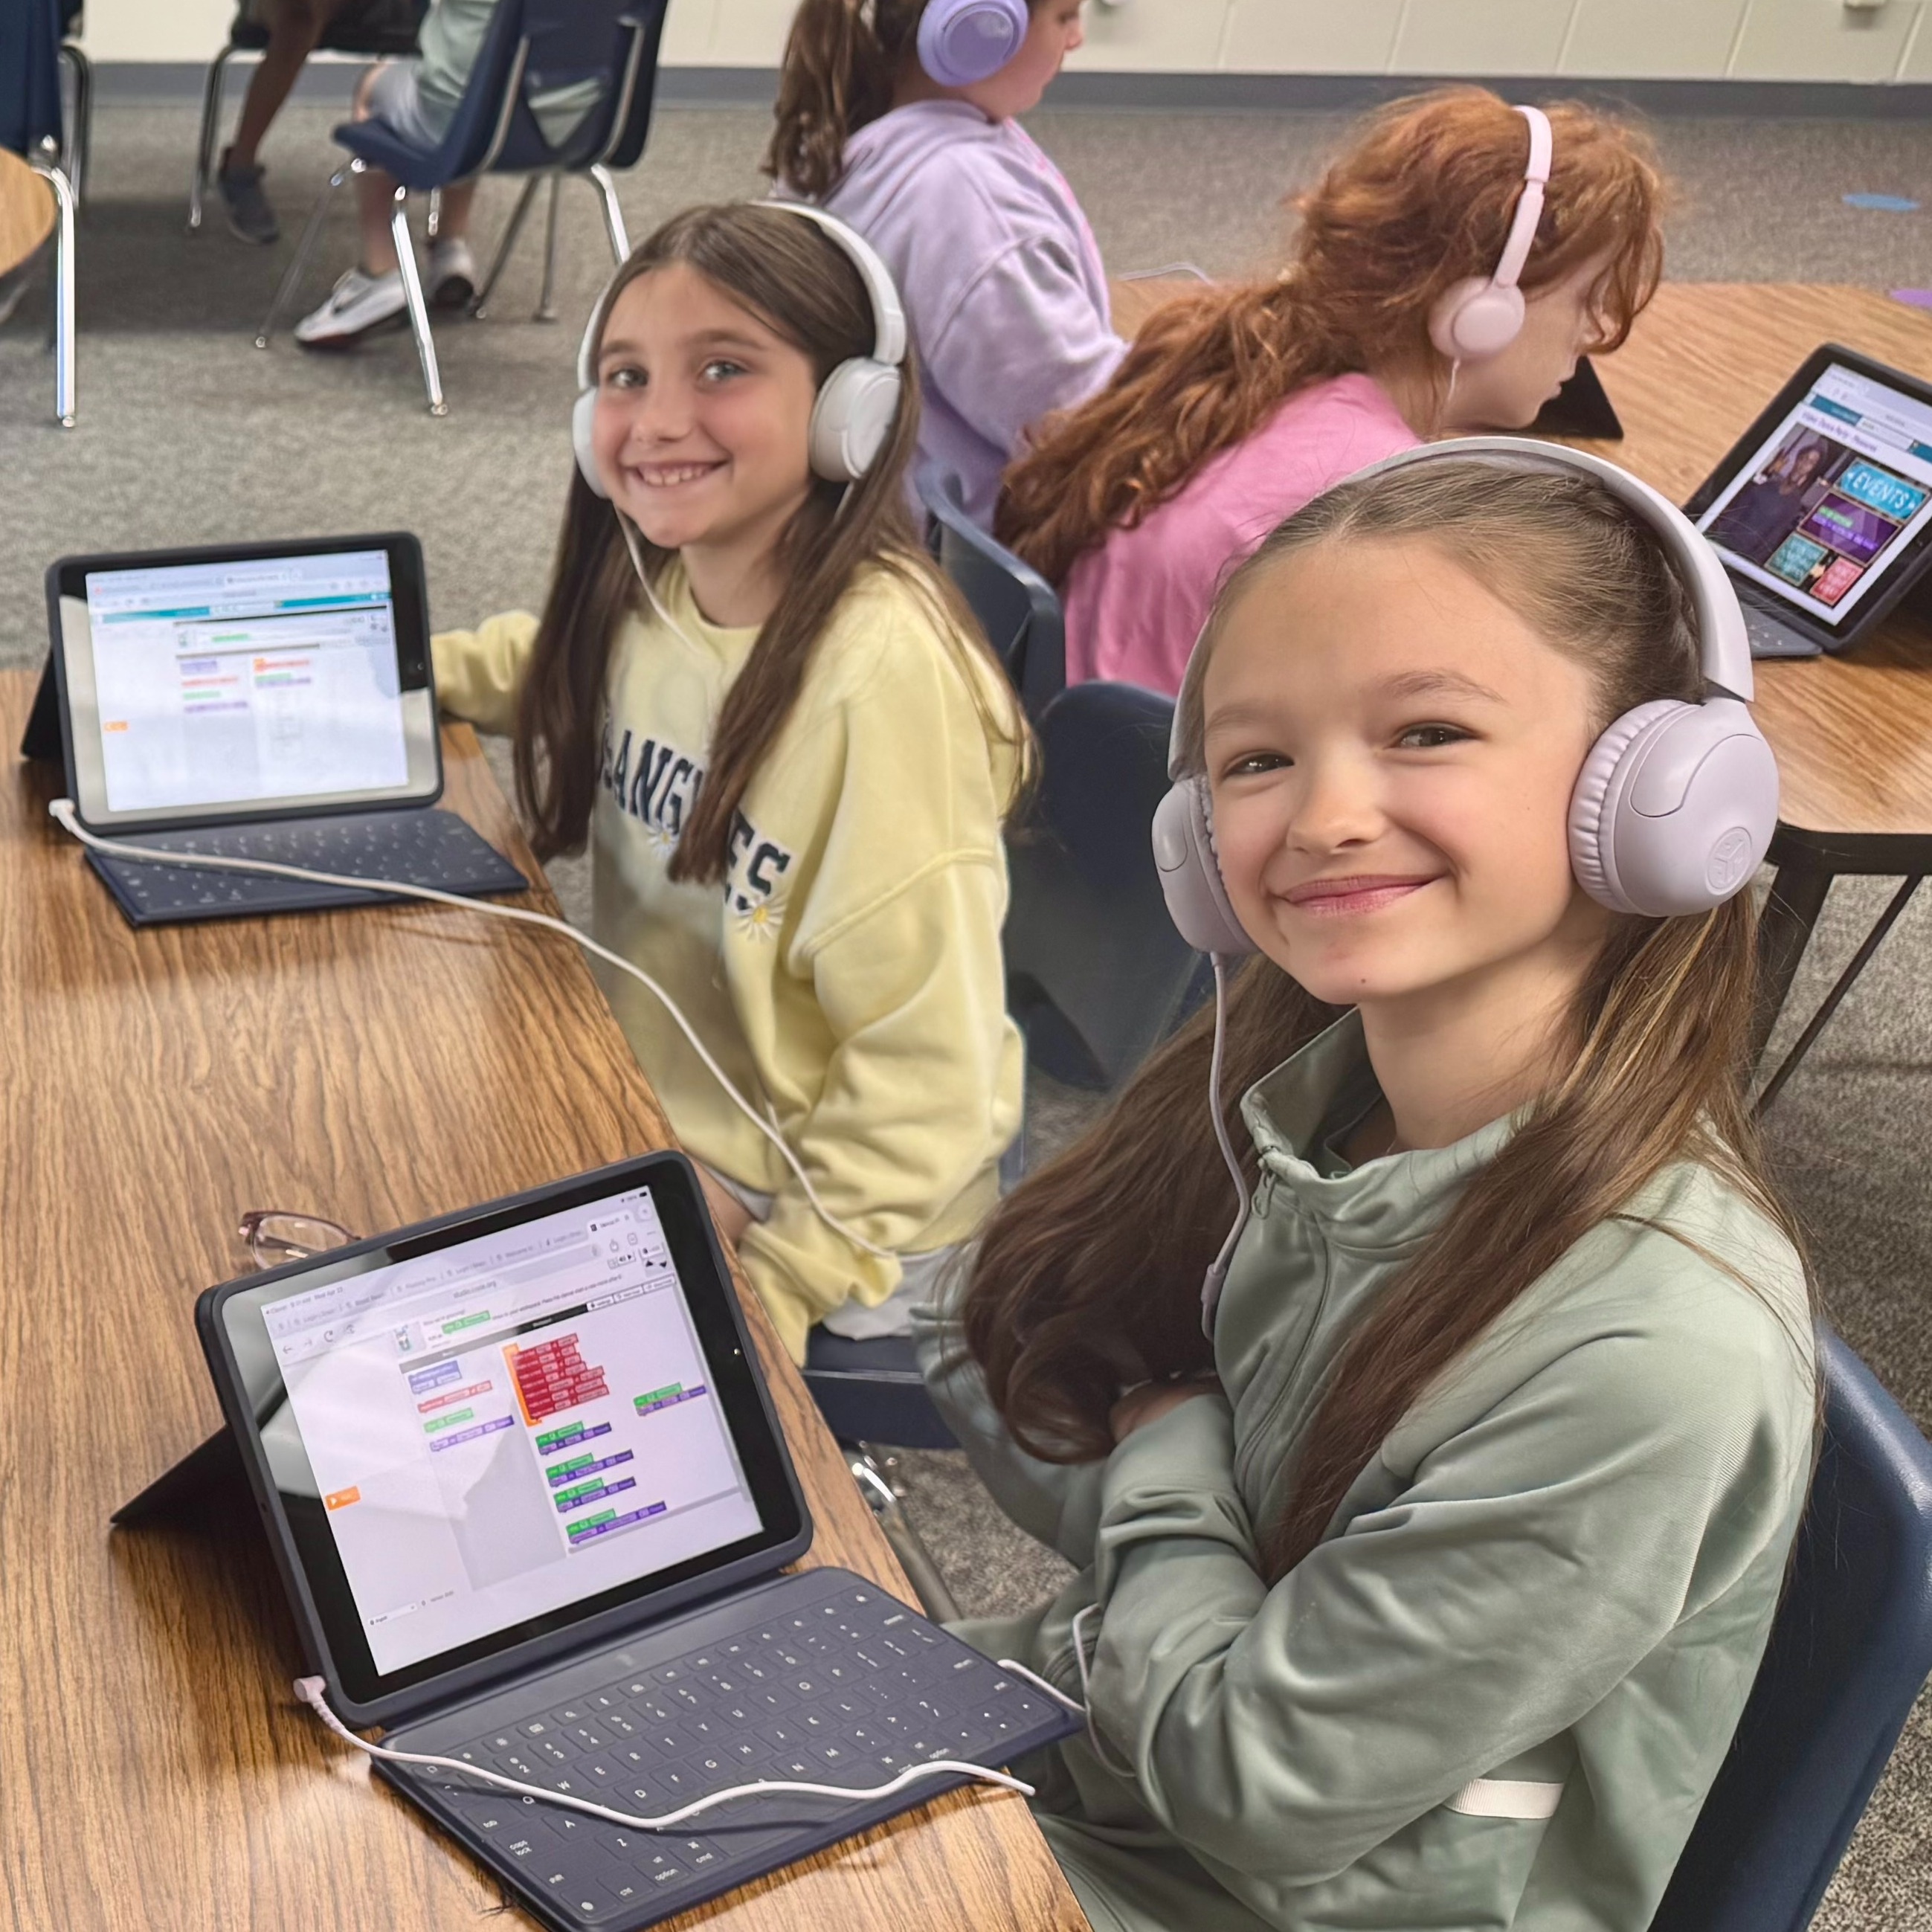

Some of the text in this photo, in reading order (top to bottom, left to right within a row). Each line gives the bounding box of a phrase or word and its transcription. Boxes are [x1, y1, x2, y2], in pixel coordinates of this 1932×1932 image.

[1852, 472, 1910, 509] EVENTS
[798, 1681, 811, 1690] O
[732, 1709, 744, 1718] U
[808, 1716, 820, 1725] K
[698, 1722, 709, 1731] Y
[739, 1745, 752, 1754] H
[825, 1748, 840, 1758] M
[553, 1750, 564, 1759] 3
[629, 1752, 641, 1761] R
[704, 1759, 718, 1768] G
[791, 1762, 805, 1772] N
[518, 1764, 531, 1774] 2
[594, 1766, 606, 1775] E
[671, 1774, 680, 1783] F
[556, 1780, 571, 1791] W
[634, 1789, 647, 1799] D
[523, 1796, 535, 1805] Q
[564, 1820, 576, 1829] A
[616, 1838, 628, 1847] Z
[695, 1852, 713, 1864] cmd
[654, 1868, 678, 1881] option
